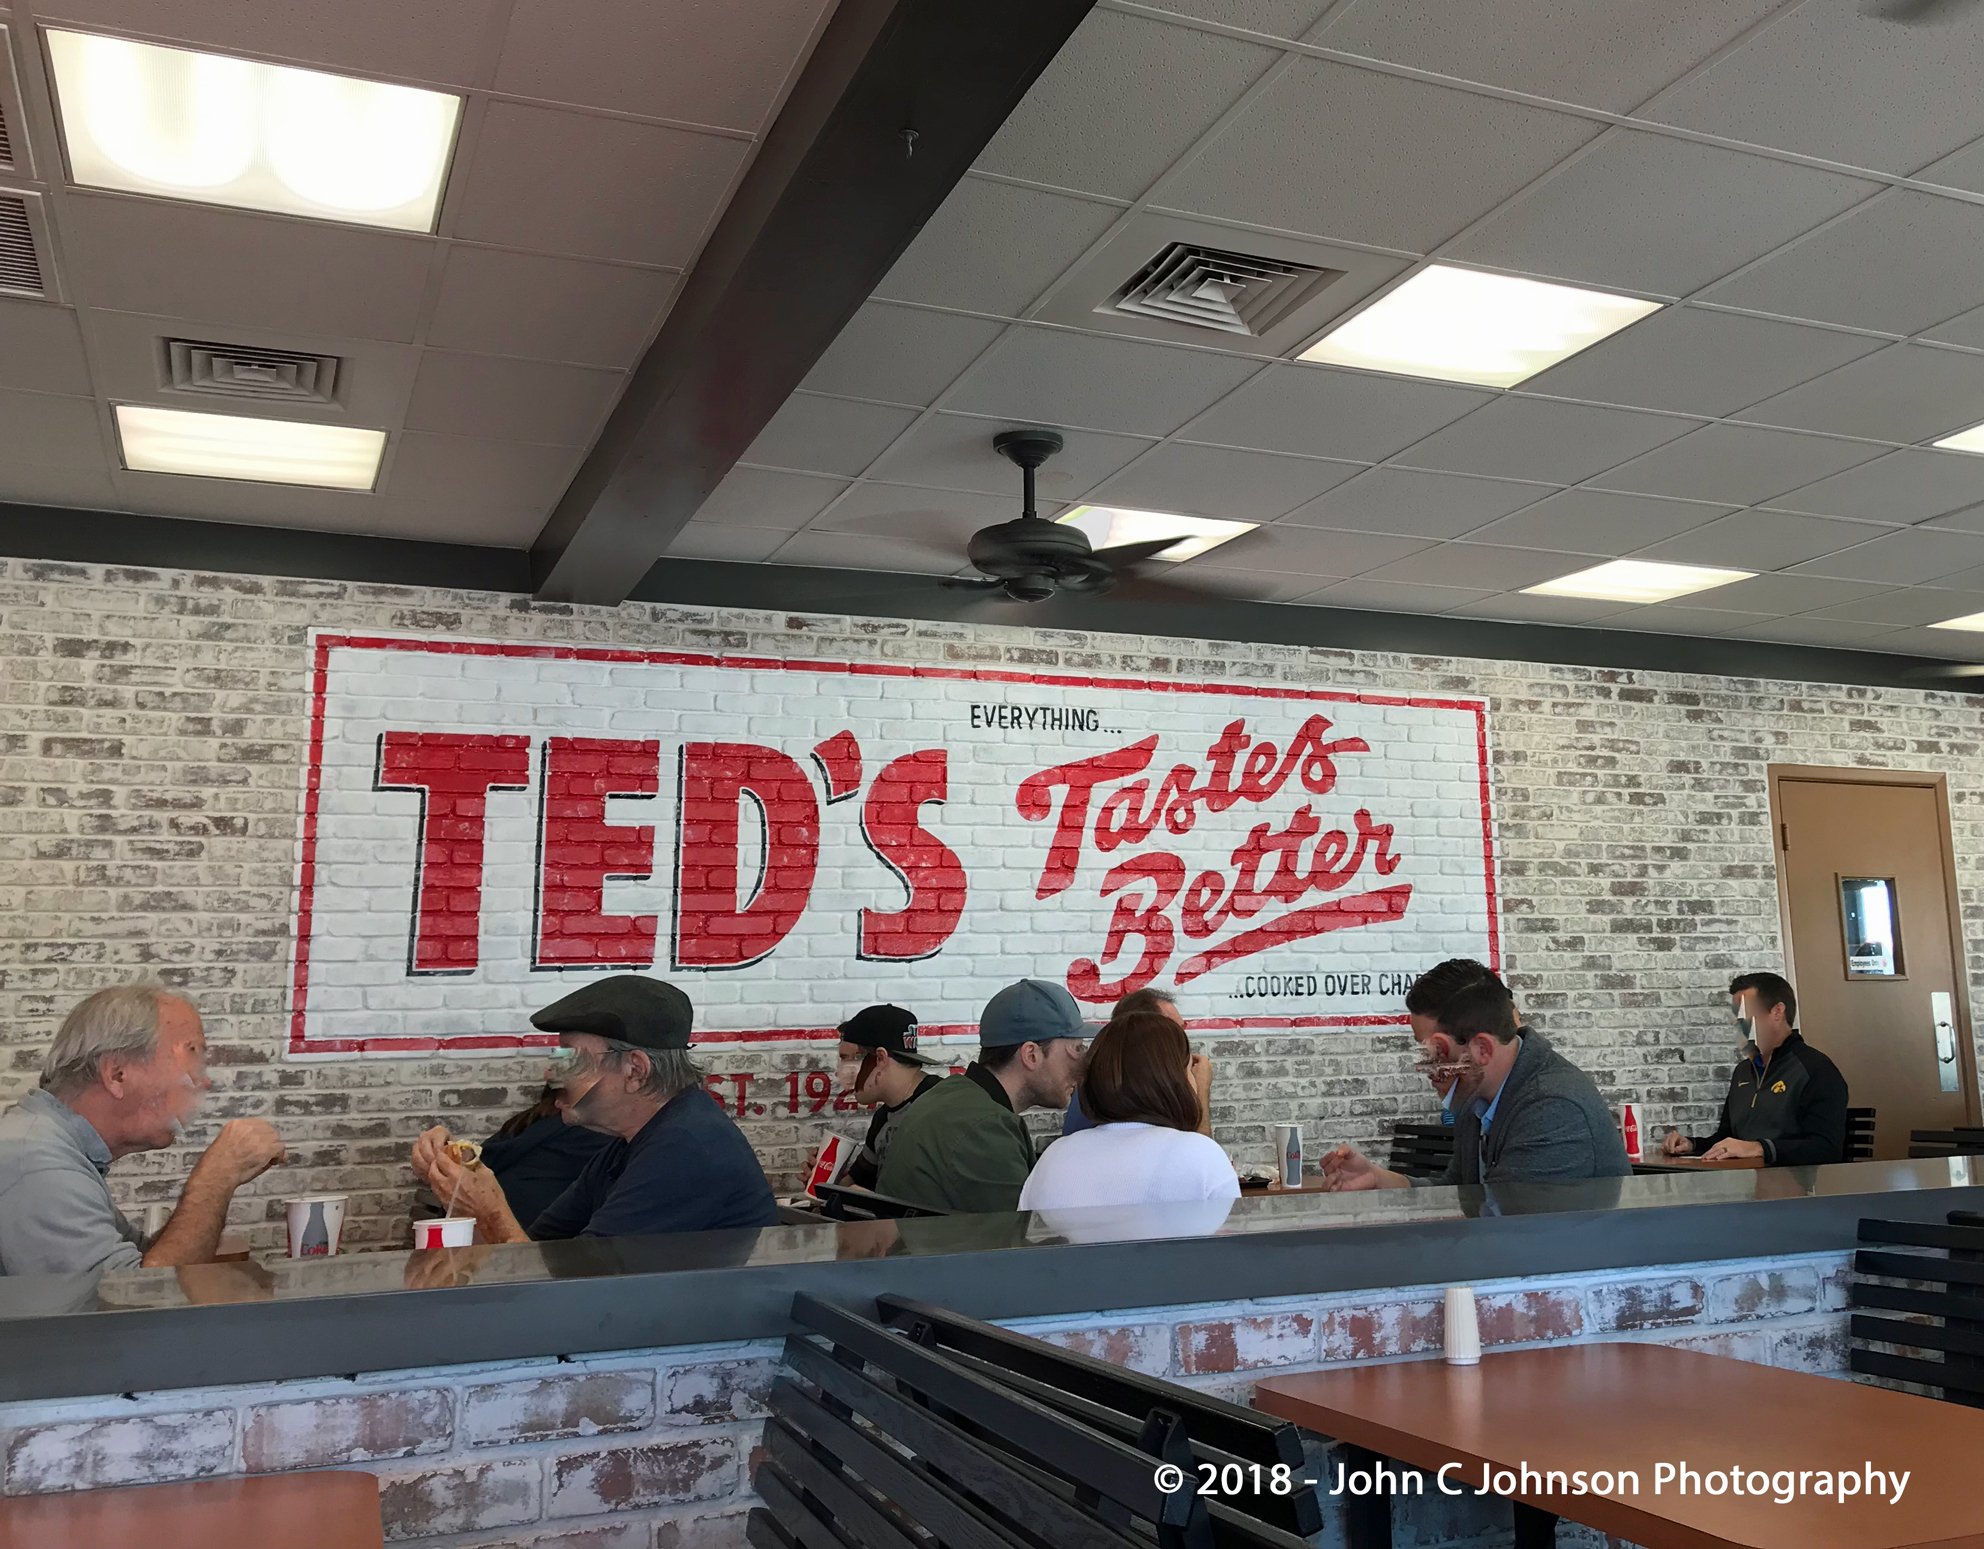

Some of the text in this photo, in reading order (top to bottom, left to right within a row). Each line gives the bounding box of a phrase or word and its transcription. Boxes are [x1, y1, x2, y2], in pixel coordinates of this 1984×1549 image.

[970, 704, 1122, 734] EVERYTHING...
[1015, 713, 1371, 900] Tastes
[373, 729, 968, 977] TED'S
[1066, 803, 1402, 1004] Better
[1325, 974, 1372, 996] OVER
